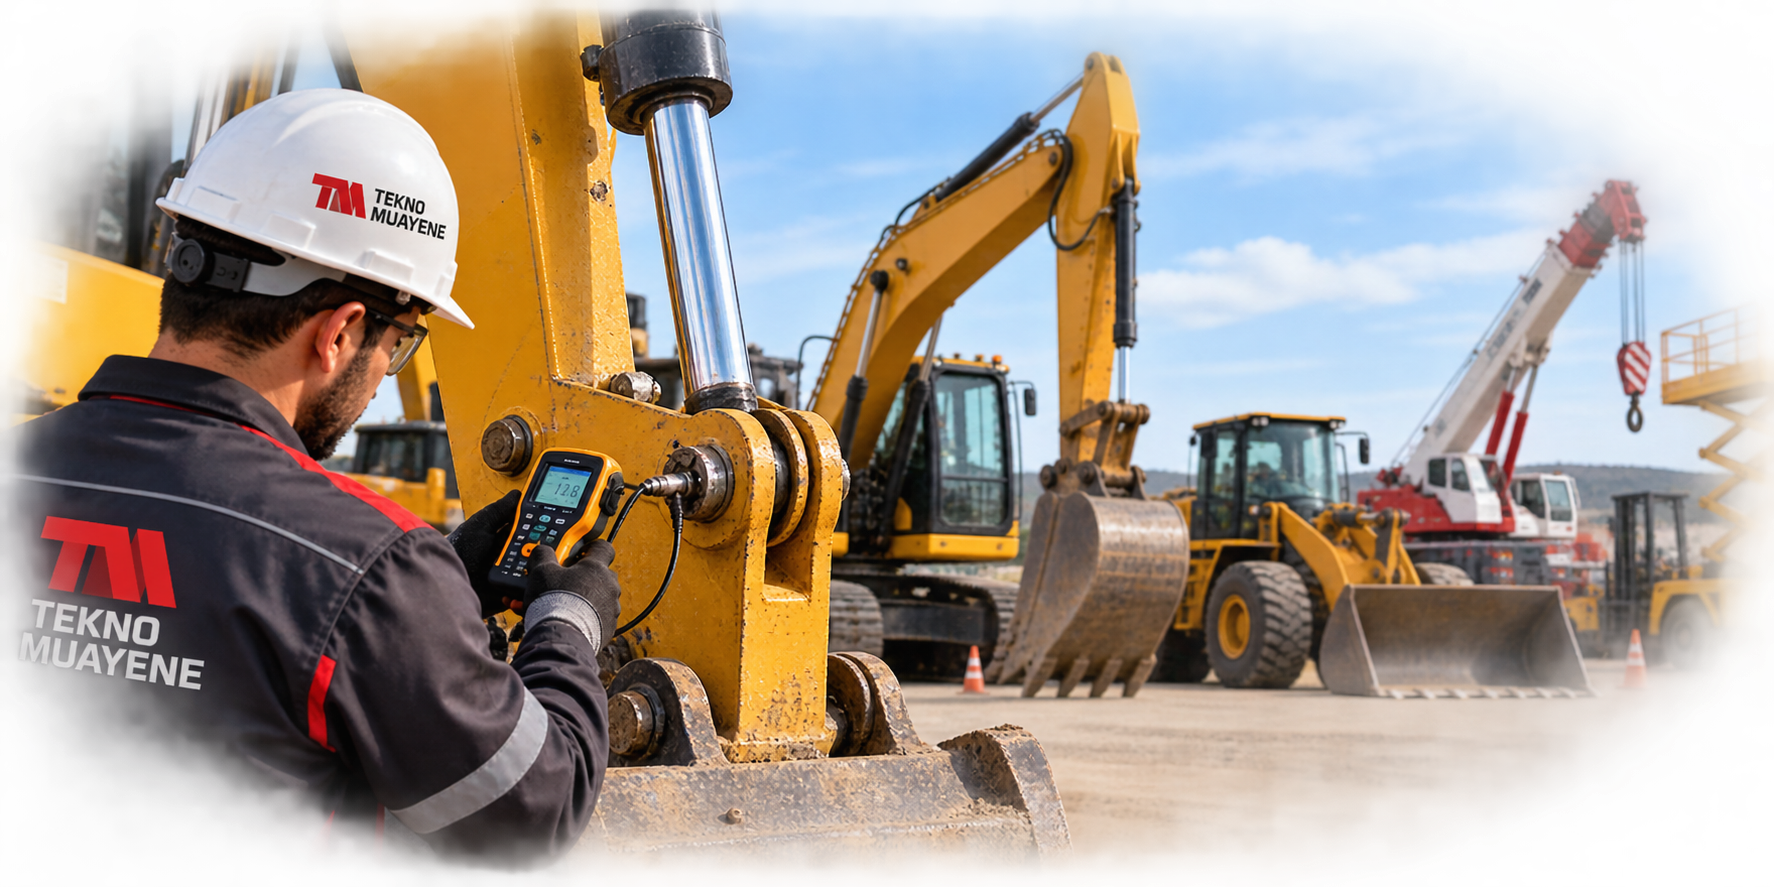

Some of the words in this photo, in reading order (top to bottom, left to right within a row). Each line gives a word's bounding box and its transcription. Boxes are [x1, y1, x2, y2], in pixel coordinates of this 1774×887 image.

[375, 188, 425, 215] TEKNO
[370, 207, 446, 240] MUAYENE
[32, 598, 160, 647] TEKNO
[19, 632, 205, 690] MUAYENE
